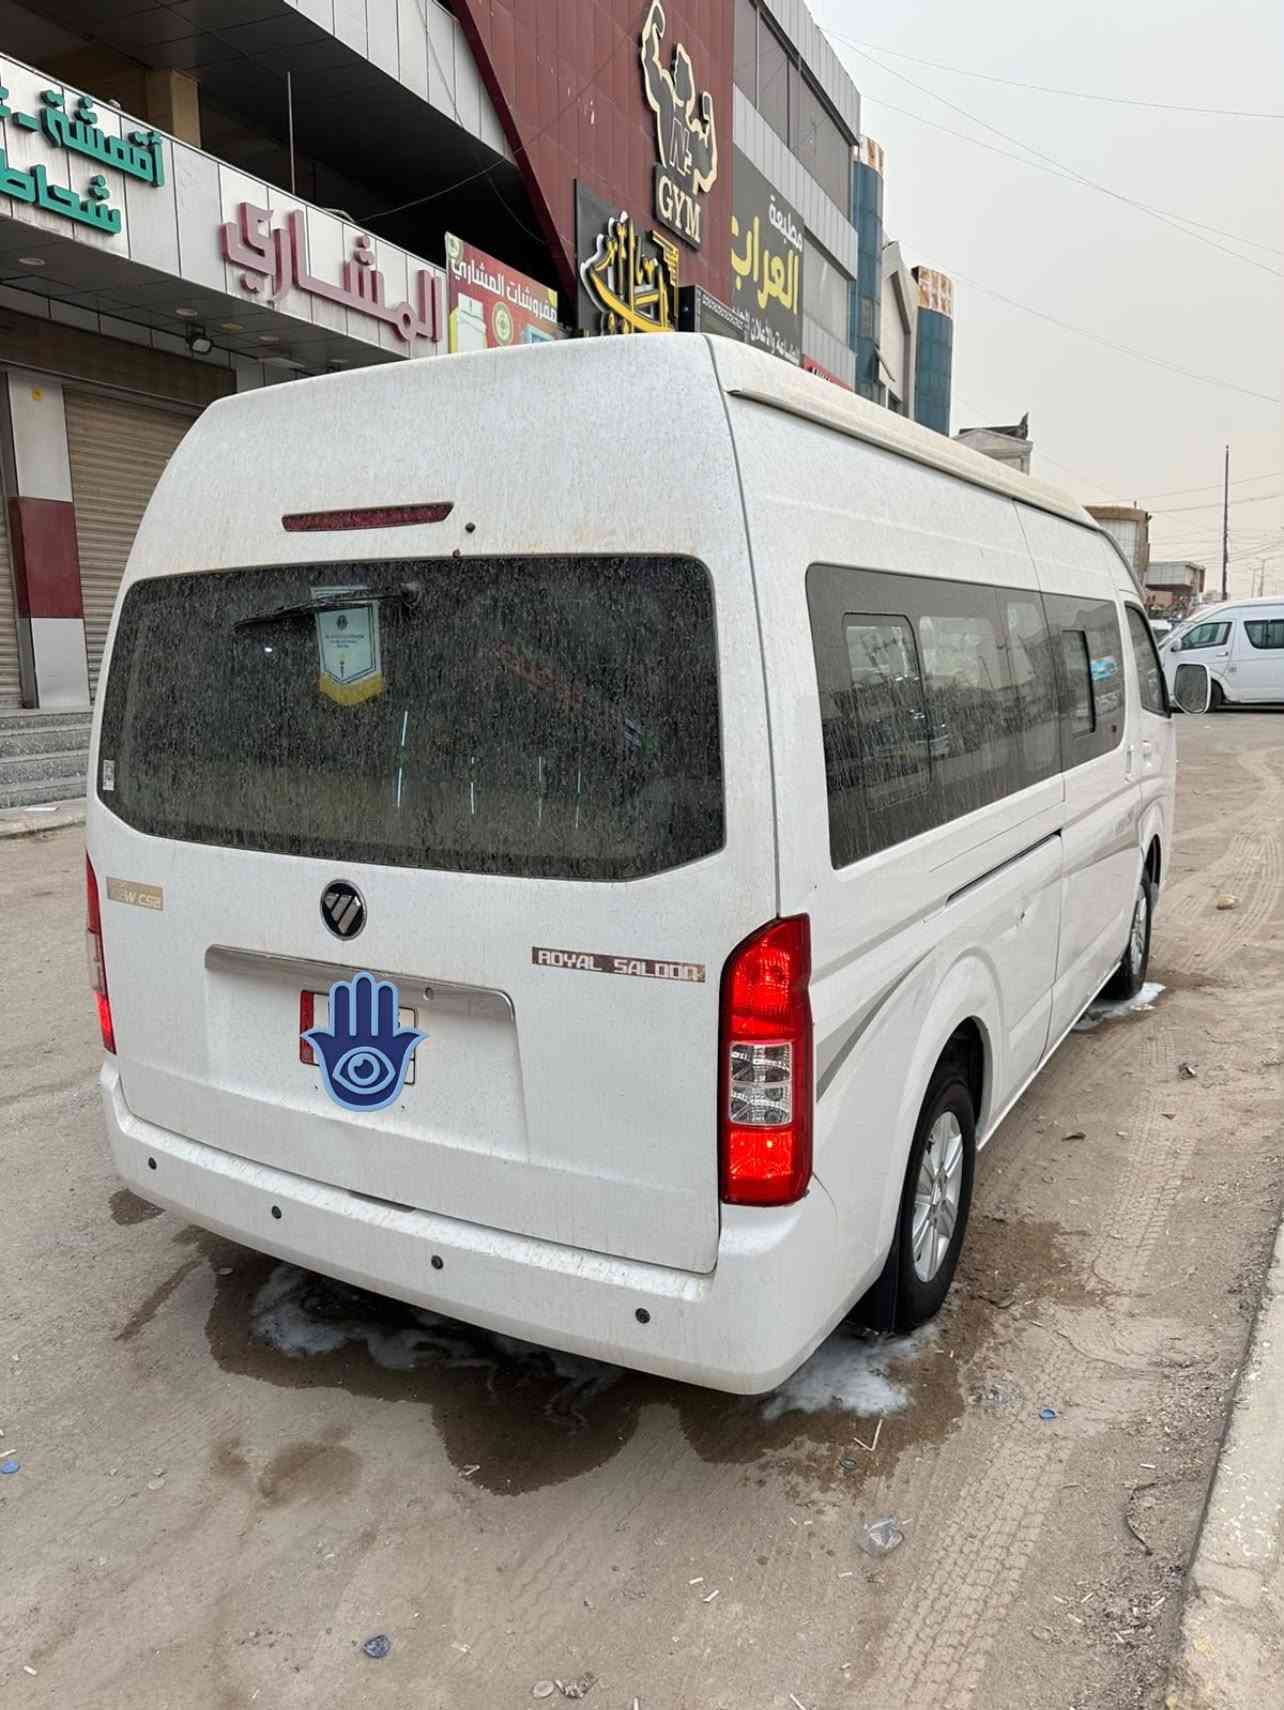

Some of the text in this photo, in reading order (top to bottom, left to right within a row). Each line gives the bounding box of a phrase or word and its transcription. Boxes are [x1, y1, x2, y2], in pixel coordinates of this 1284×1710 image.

[657, 174, 702, 244] GYM
[768, 193, 802, 253] مطبعة
[220, 201, 440, 343] المشاري
[450, 258, 558, 323] مفروشات المشاري
[731, 215, 799, 315] العراب
[538, 950, 705, 982] ROYAL SALOON
